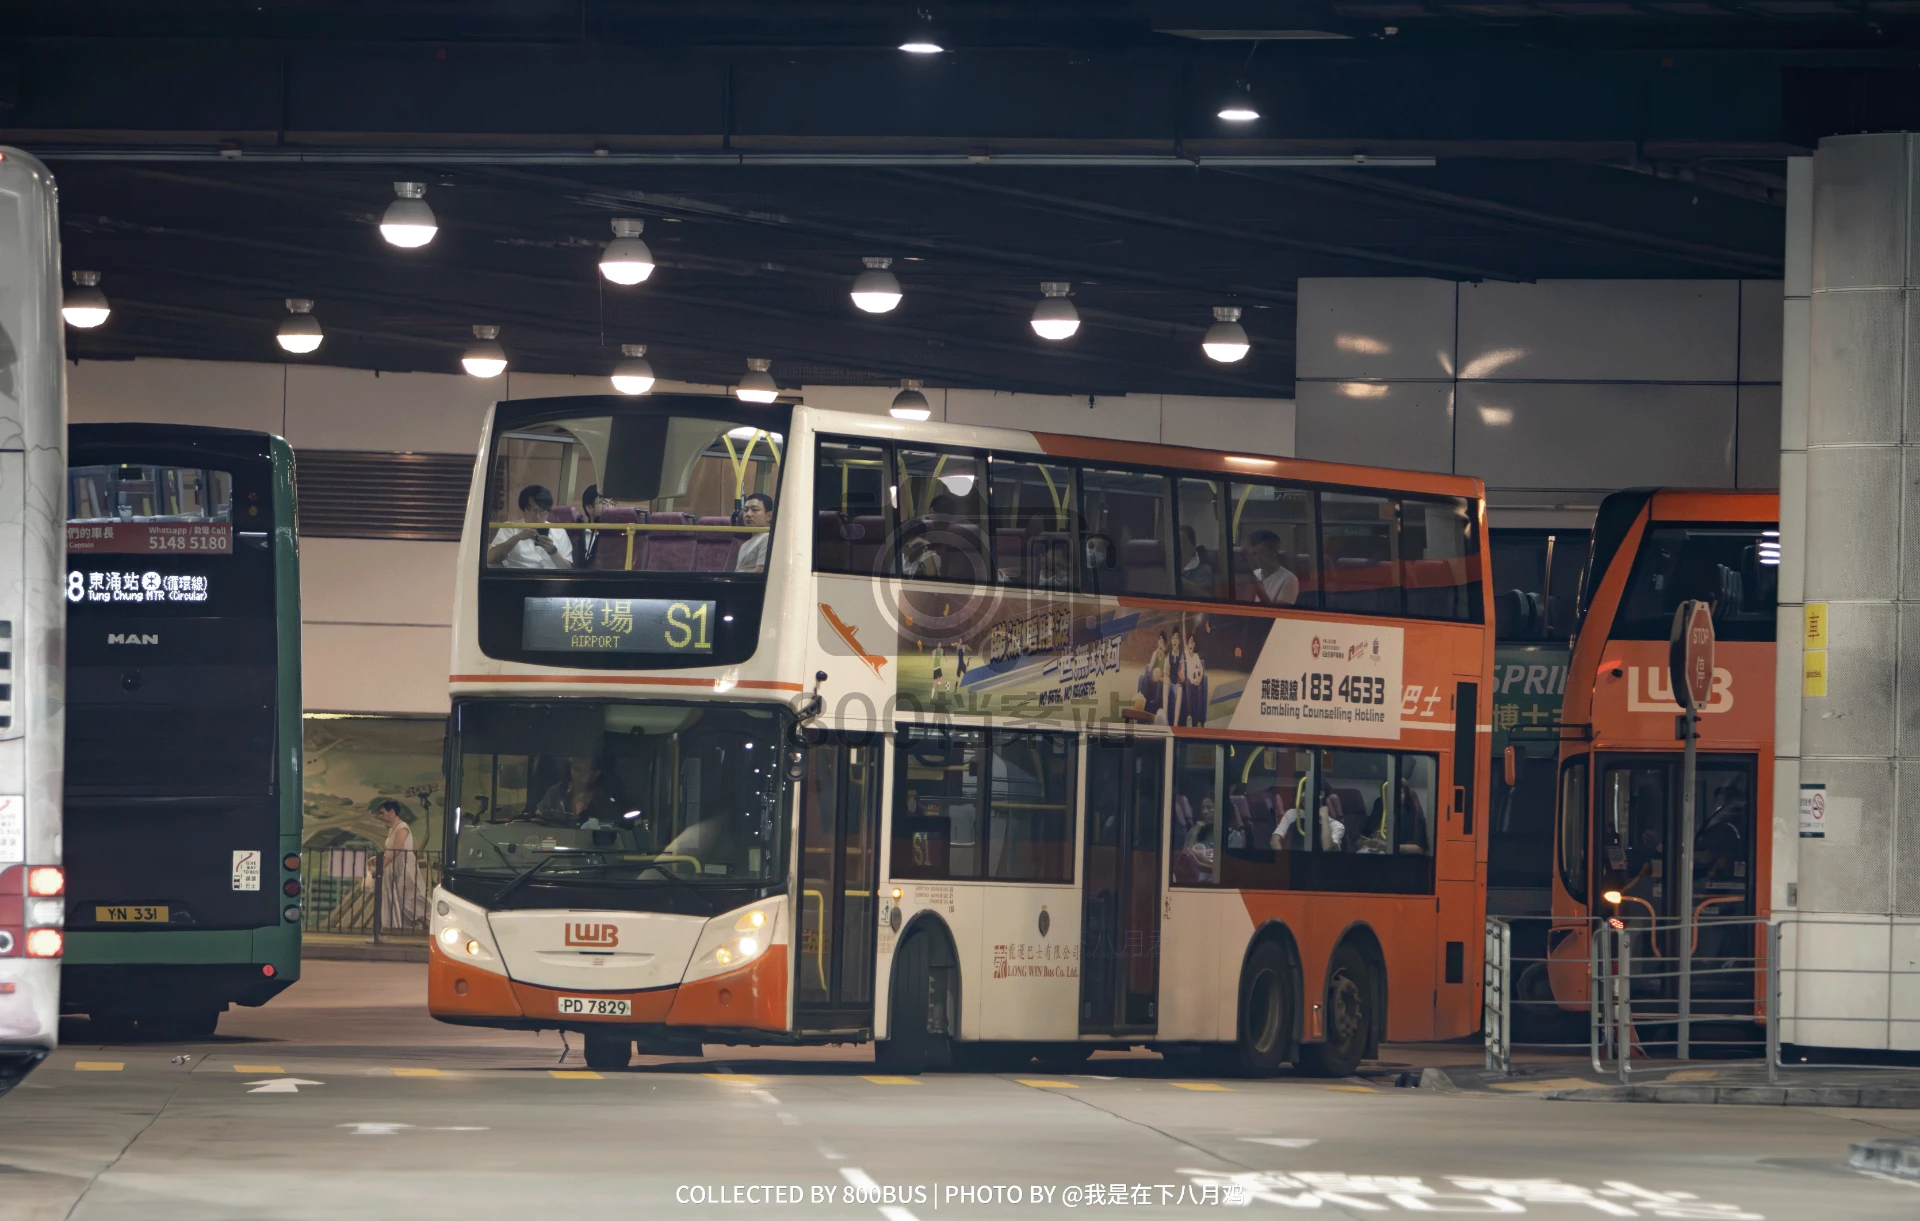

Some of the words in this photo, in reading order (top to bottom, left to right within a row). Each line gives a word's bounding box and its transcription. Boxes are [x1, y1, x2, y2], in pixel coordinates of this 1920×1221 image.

[66, 526, 114, 539] 們的車長
[212, 526, 226, 535] Call
[149, 537, 186, 550] 5148
[190, 537, 226, 550] 5180
[64, 571, 85, 602] 8
[88, 571, 140, 591] 東涌站
[88, 590, 111, 602] Tung
[113, 590, 144, 602] Chung
[146, 590, 165, 601] MTR
[168, 590, 208, 601] (Circular)
[562, 597, 634, 634] 機場
[664, 602, 711, 650] S1
[107, 633, 159, 645] MAN
[571, 635, 621, 649] AIRPORT
[1692, 627, 1710, 645] STOP
[1301, 672, 1333, 702] 183
[1338, 675, 1385, 705] 4633
[1260, 702, 1300, 720] Gambling
[1303, 704, 1352, 723] Counselling
[1355, 707, 1385, 723] Hotline
[107, 908, 128, 920] YN
[133, 907, 158, 920] 331
[564, 922, 619, 948] LWB
[1007, 965, 1027, 977] LONG
[1028, 965, 1043, 977] WIN
[1043, 965, 1055, 977] Bus
[1055, 965, 1065, 978] Co.
[563, 999, 584, 1014] PD
[587, 1000, 628, 1015] 7829
